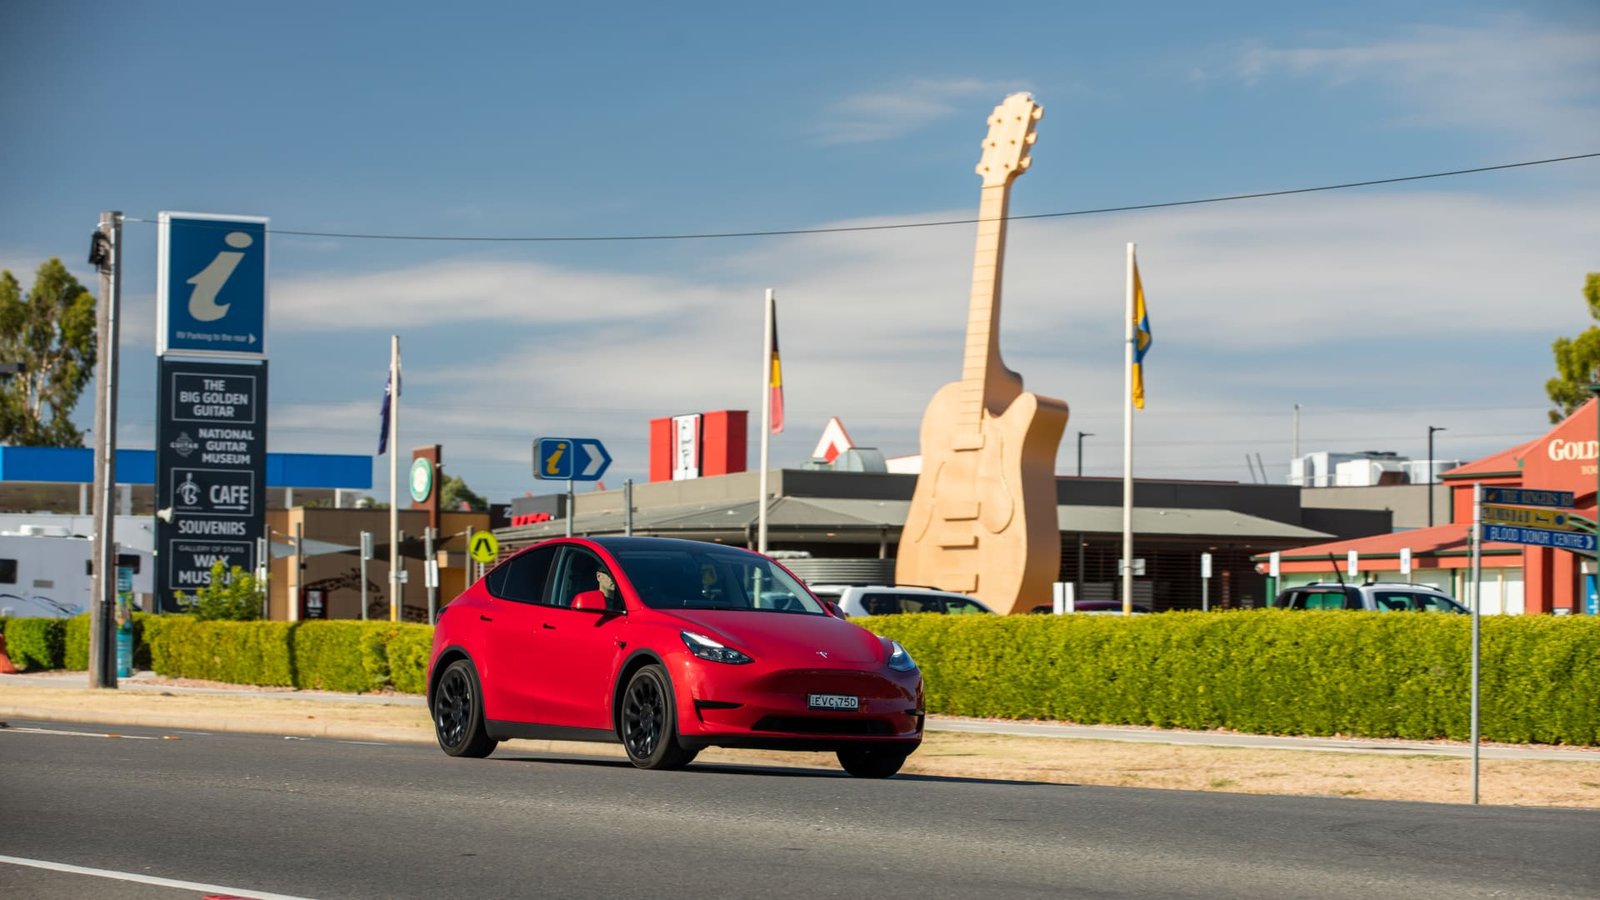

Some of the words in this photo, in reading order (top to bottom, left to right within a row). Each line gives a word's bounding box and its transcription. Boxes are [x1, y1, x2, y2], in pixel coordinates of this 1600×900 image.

[203, 380, 225, 391] THE
[180, 391, 200, 403] BIG
[202, 393, 248, 405] GOLDEN
[193, 405, 234, 417] GUITAR
[198, 428, 255, 440] NATIONAL
[205, 441, 247, 452] GUITAR
[202, 453, 252, 464] MUSEUM
[209, 485, 249, 504] CAFE
[178, 520, 246, 535] SOUVENIRS
[1490, 527, 1519, 540] BLOOD
[1522, 530, 1549, 544] DONOR
[1553, 533, 1584, 548] CENTRE
[193, 554, 229, 568] WAX
